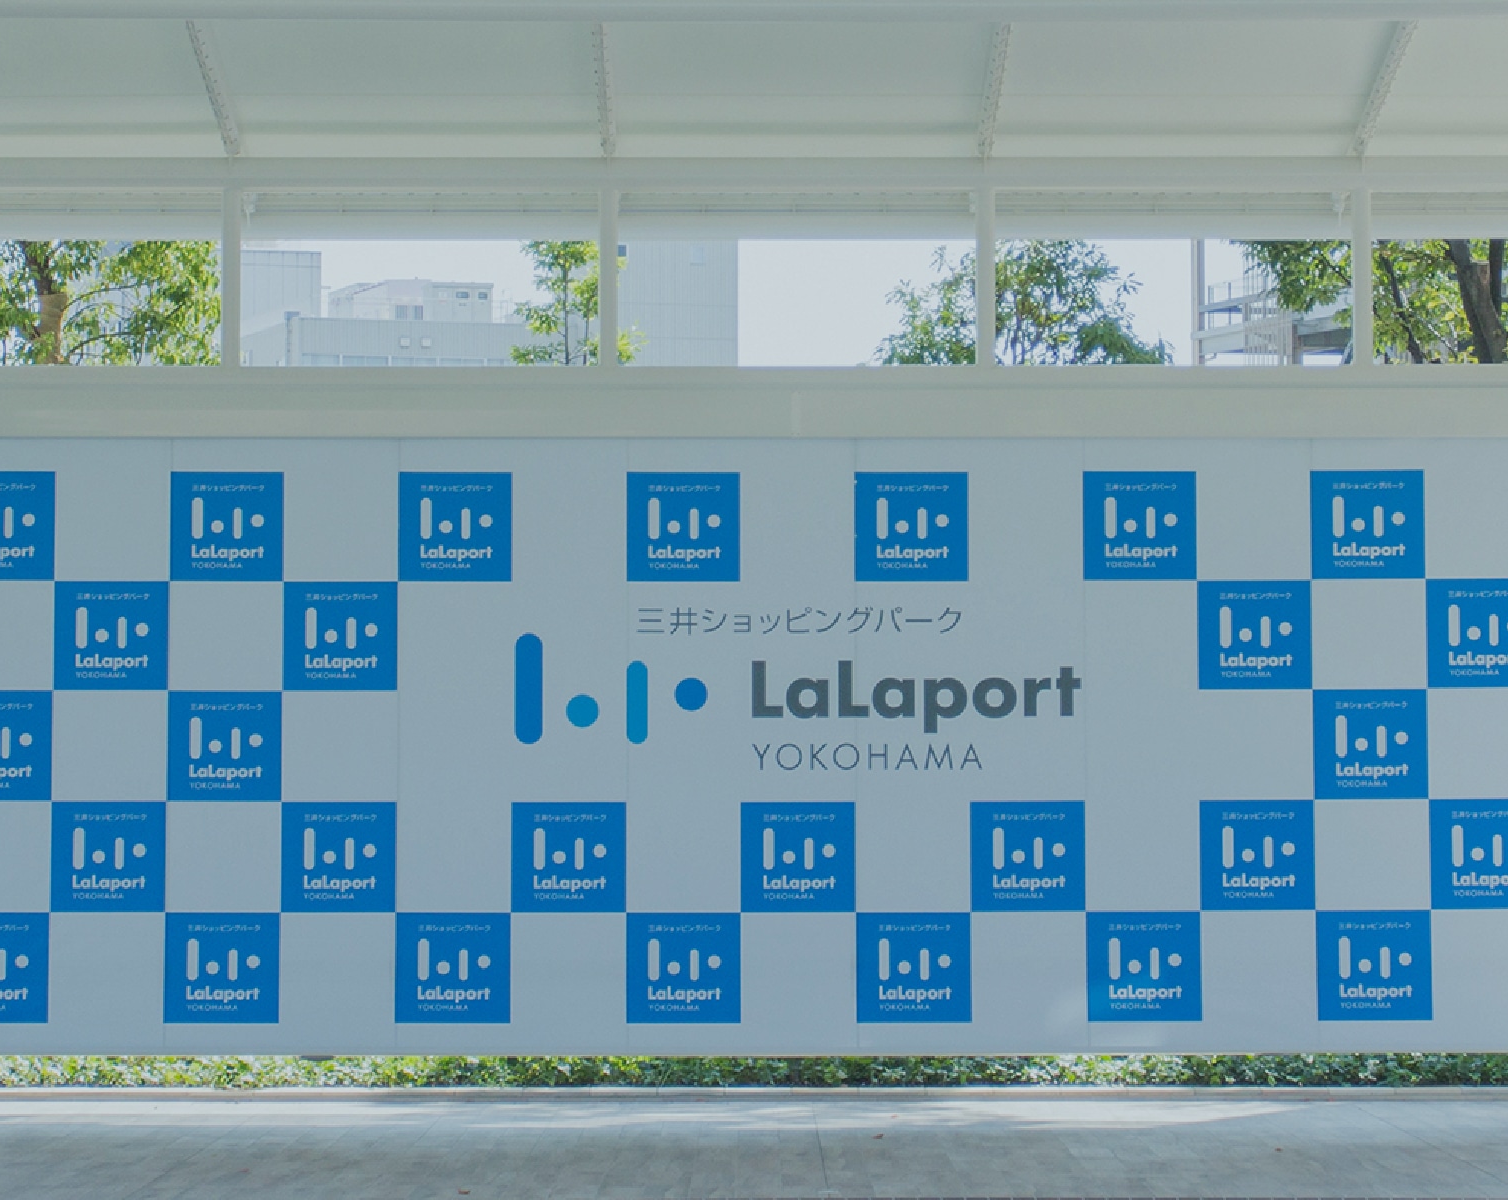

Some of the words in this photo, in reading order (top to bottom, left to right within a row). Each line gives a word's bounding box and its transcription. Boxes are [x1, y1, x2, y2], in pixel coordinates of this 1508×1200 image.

[190, 543, 265, 562] LaLaport
[419, 543, 494, 562] LaLaport
[647, 543, 722, 562] LaLaport
[875, 543, 950, 562] LaLaport
[1103, 543, 1179, 562] LaLaport
[1332, 541, 1407, 560] LaLaport
[636, 607, 963, 635] 三井ショッピングパーク
[74, 653, 149, 672] LaLaport
[304, 653, 379, 672] LaLaport
[1219, 651, 1293, 670] LaLaport
[751, 660, 1083, 734] LaLaport
[752, 743, 983, 771] YOKOHAMA
[188, 763, 263, 782] LaLaport
[1335, 761, 1410, 780] LaLaport
[71, 874, 146, 893] LaLaport
[302, 874, 378, 893] LaLaport
[532, 874, 607, 893] LaLaport
[762, 874, 837, 893] LaLaport
[992, 874, 1067, 893] LaLaport
[1221, 872, 1296, 891] LaLaport
[185, 985, 261, 1004] LaLaport
[416, 985, 491, 1004] LaLaport
[647, 985, 722, 1004] LaLaport
[878, 984, 953, 1003] LaLaport
[1108, 984, 1183, 1003] LaLaport
[1338, 982, 1413, 1001] LaLaport
